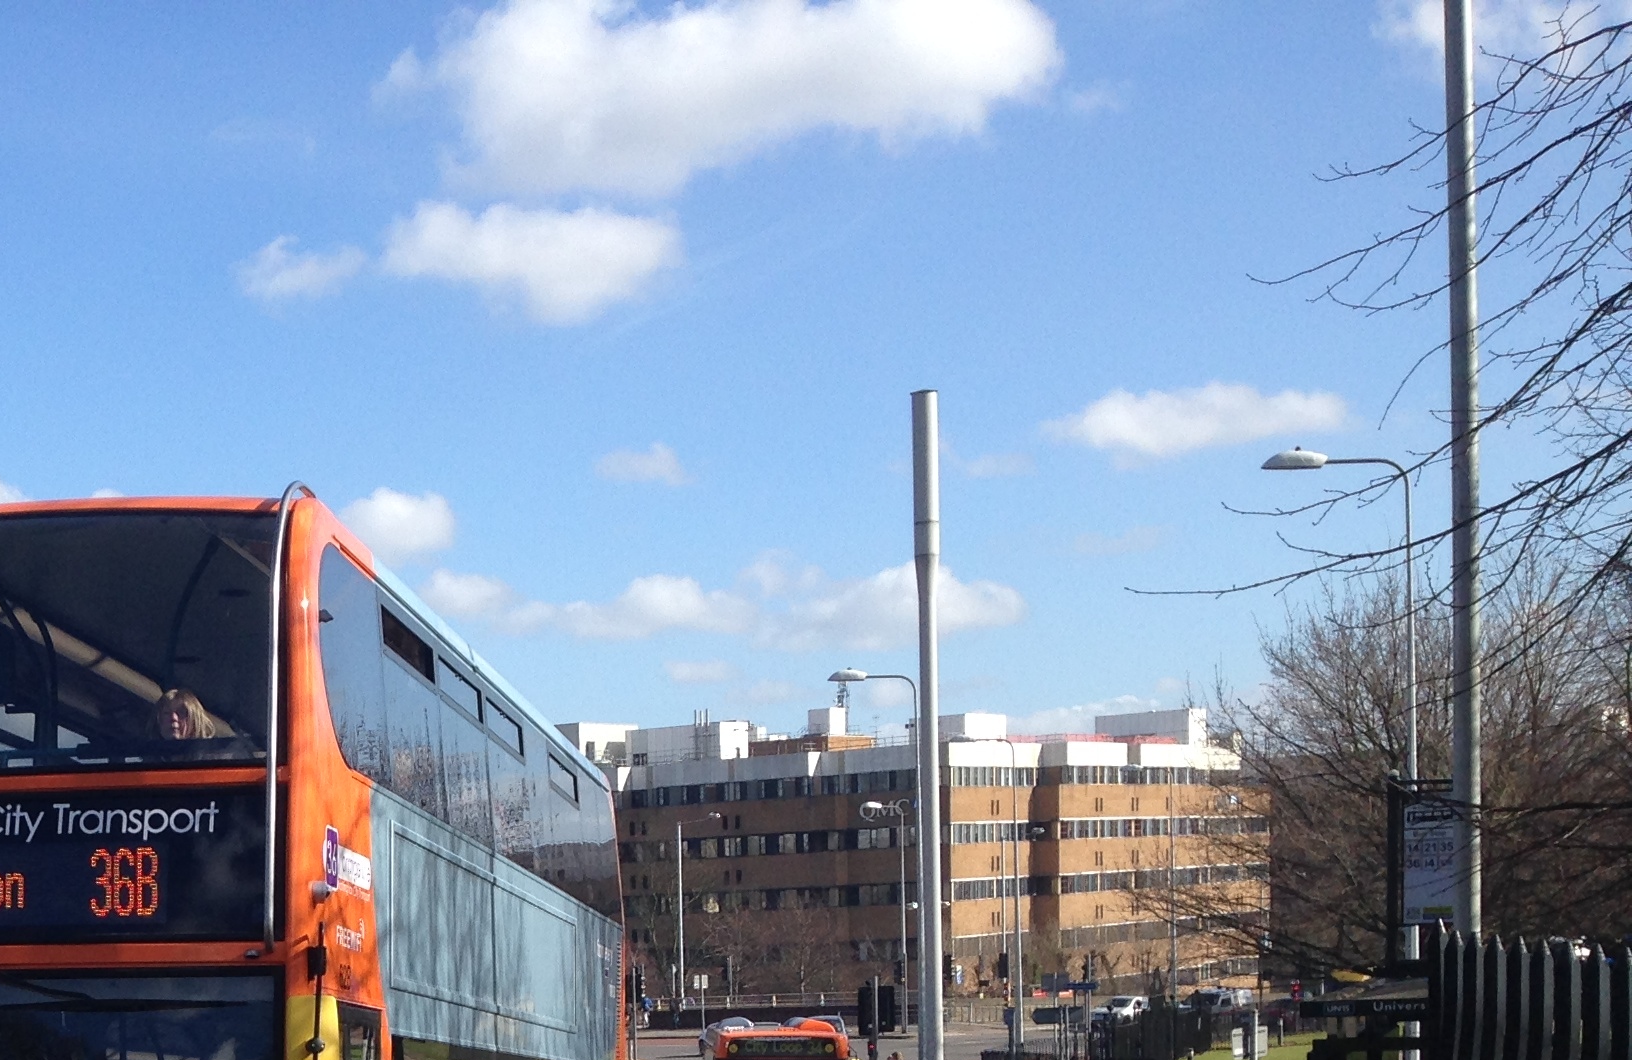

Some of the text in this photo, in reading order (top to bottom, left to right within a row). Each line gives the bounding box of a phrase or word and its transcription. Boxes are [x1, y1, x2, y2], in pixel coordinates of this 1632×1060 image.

[53, 800, 219, 841] Transport
[327, 840, 337, 876] 36
[90, 846, 159, 918] 36B
[1372, 1001, 1426, 1012] Univers
